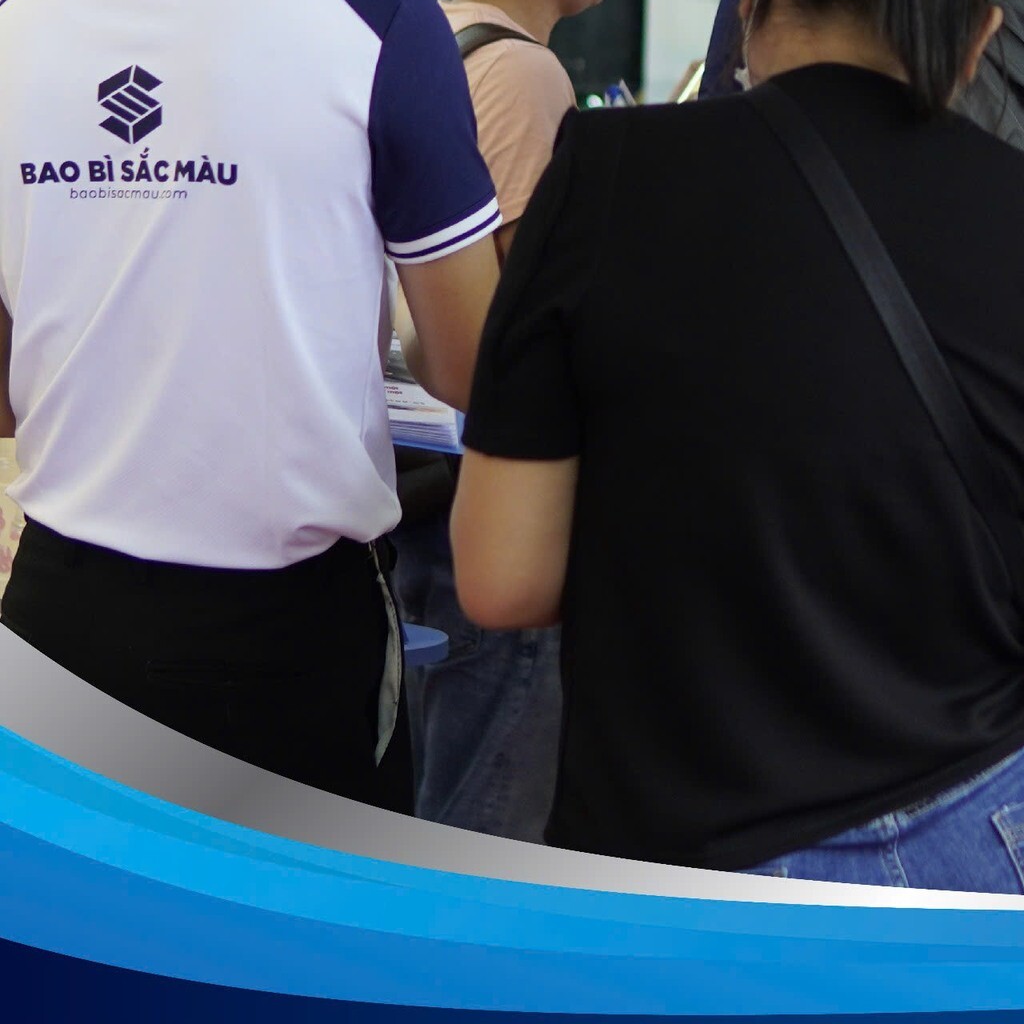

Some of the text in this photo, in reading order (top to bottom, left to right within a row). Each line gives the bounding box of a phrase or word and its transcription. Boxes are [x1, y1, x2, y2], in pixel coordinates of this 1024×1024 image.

[20, 147, 239, 186] BAO BÌ SẮC MÀU
